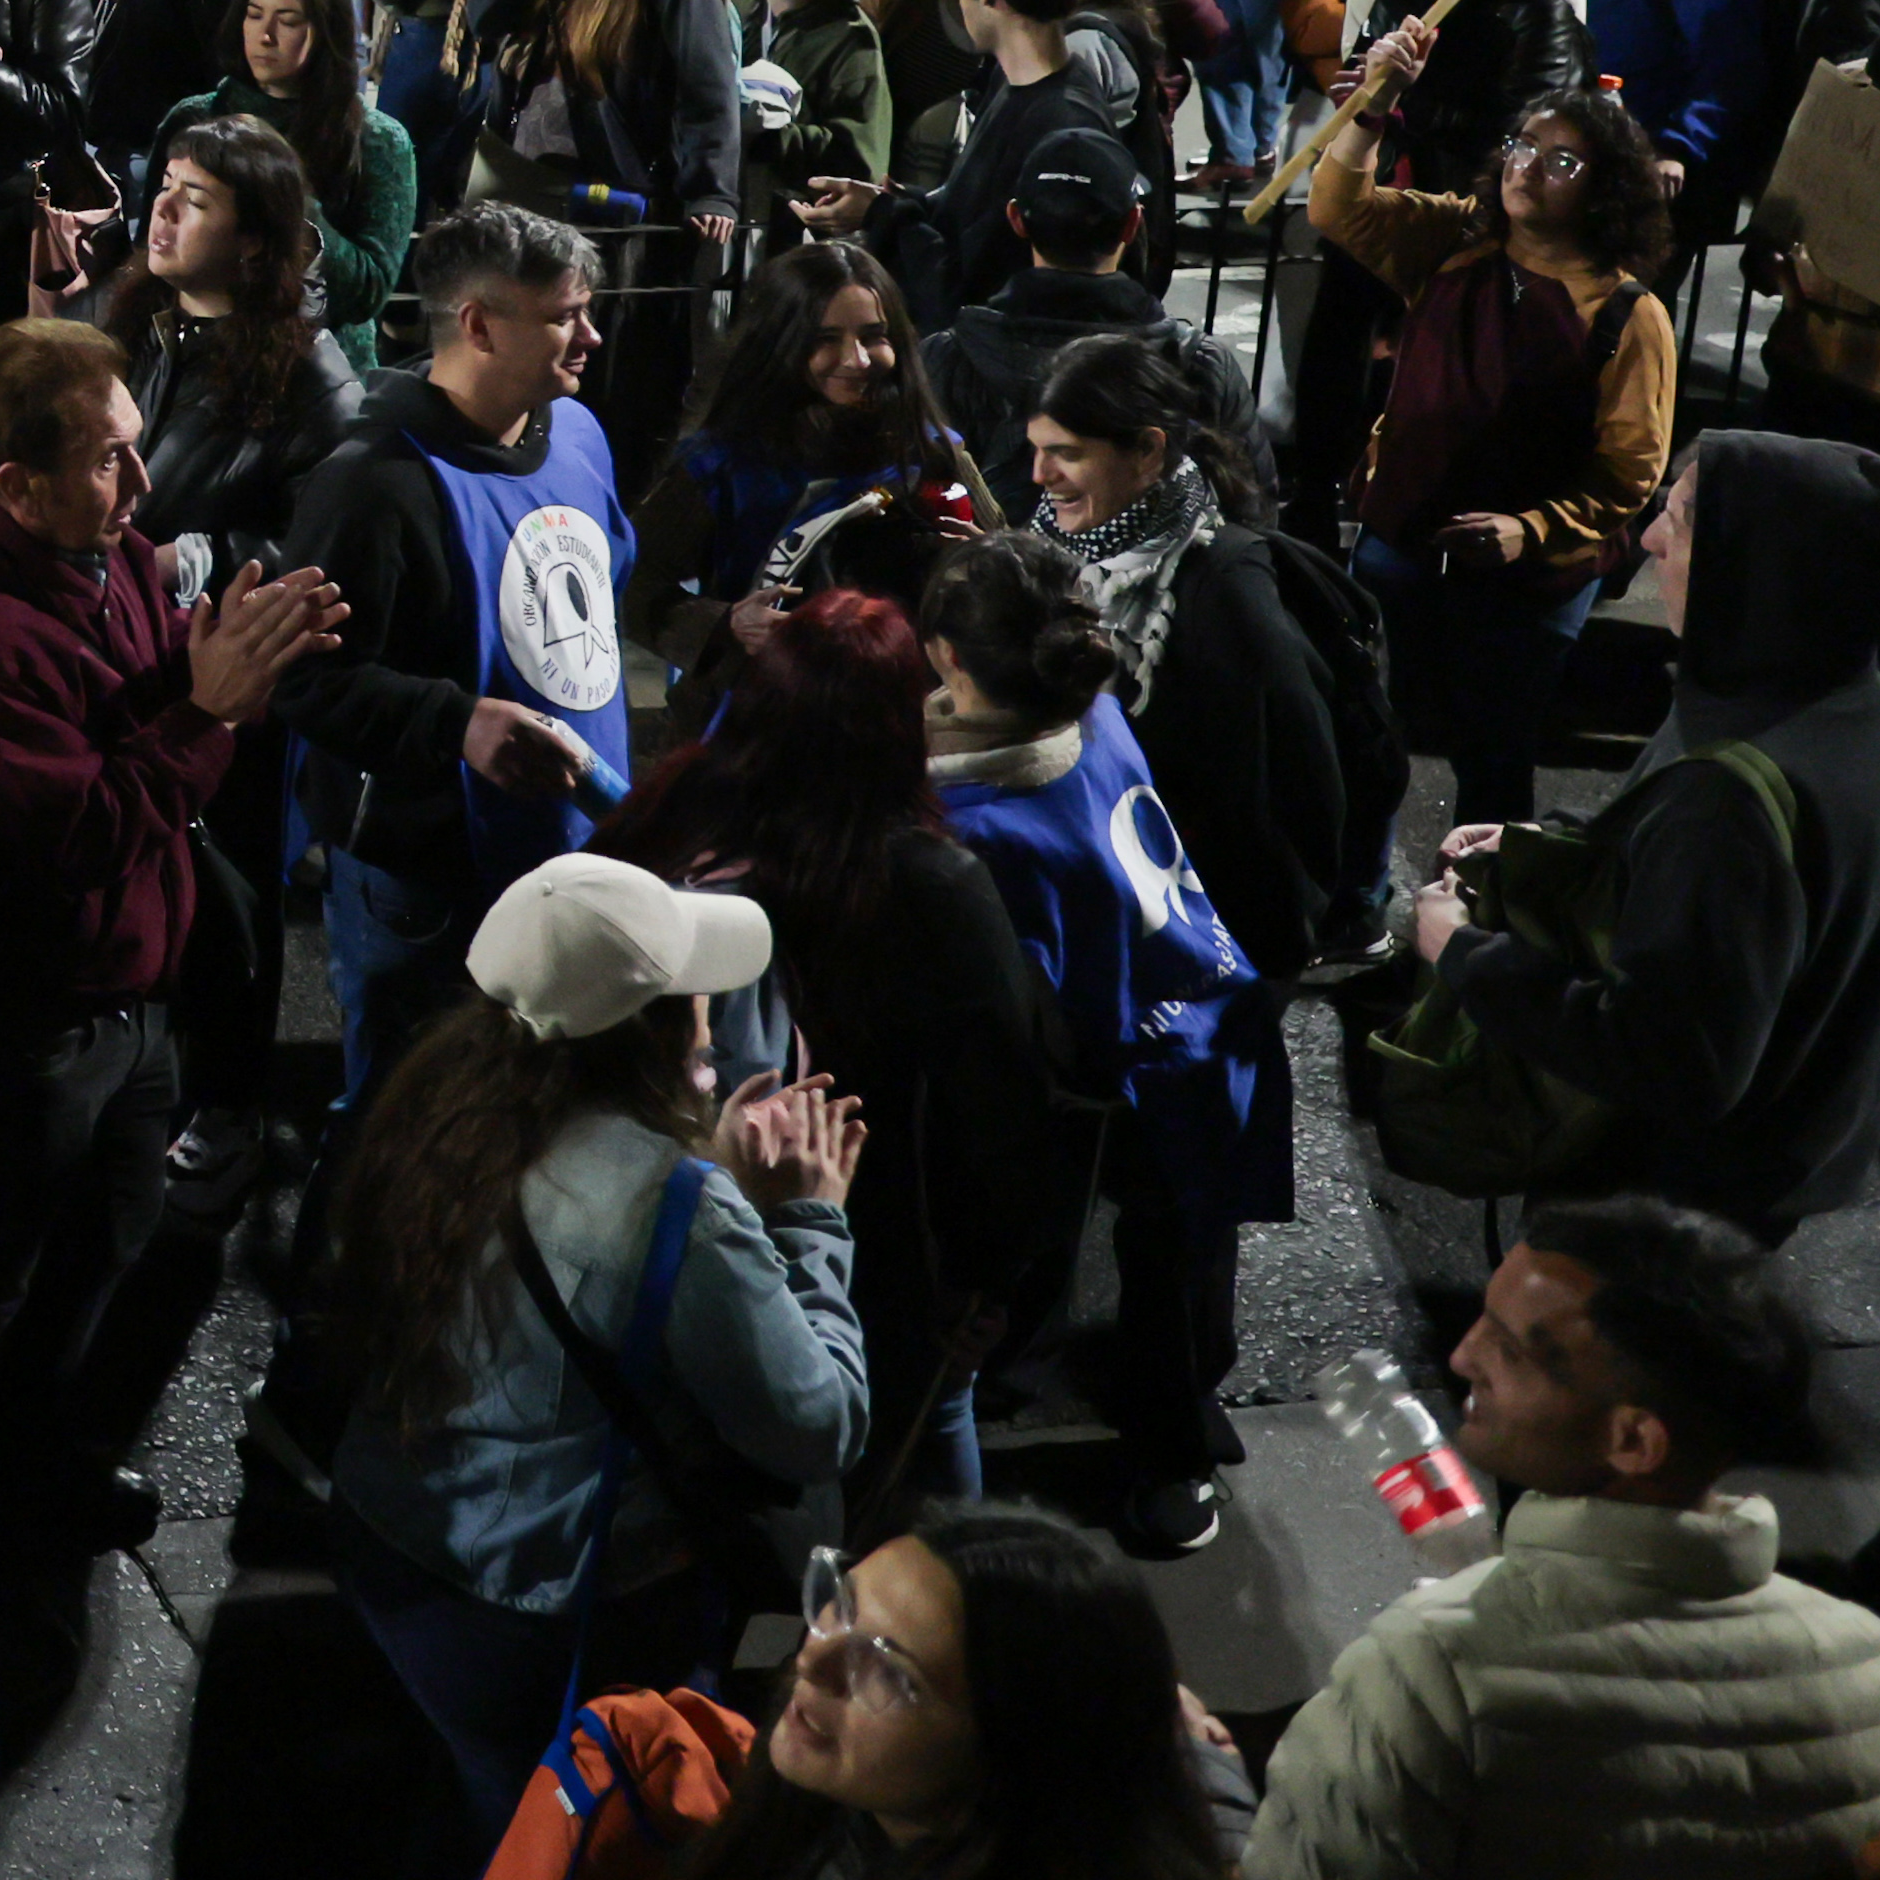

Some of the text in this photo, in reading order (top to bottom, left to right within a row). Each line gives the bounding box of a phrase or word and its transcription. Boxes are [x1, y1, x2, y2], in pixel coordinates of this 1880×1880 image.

[540, 657, 558, 680] NI
[562, 677, 579, 700] UN
[587, 677, 611, 704] PASO
